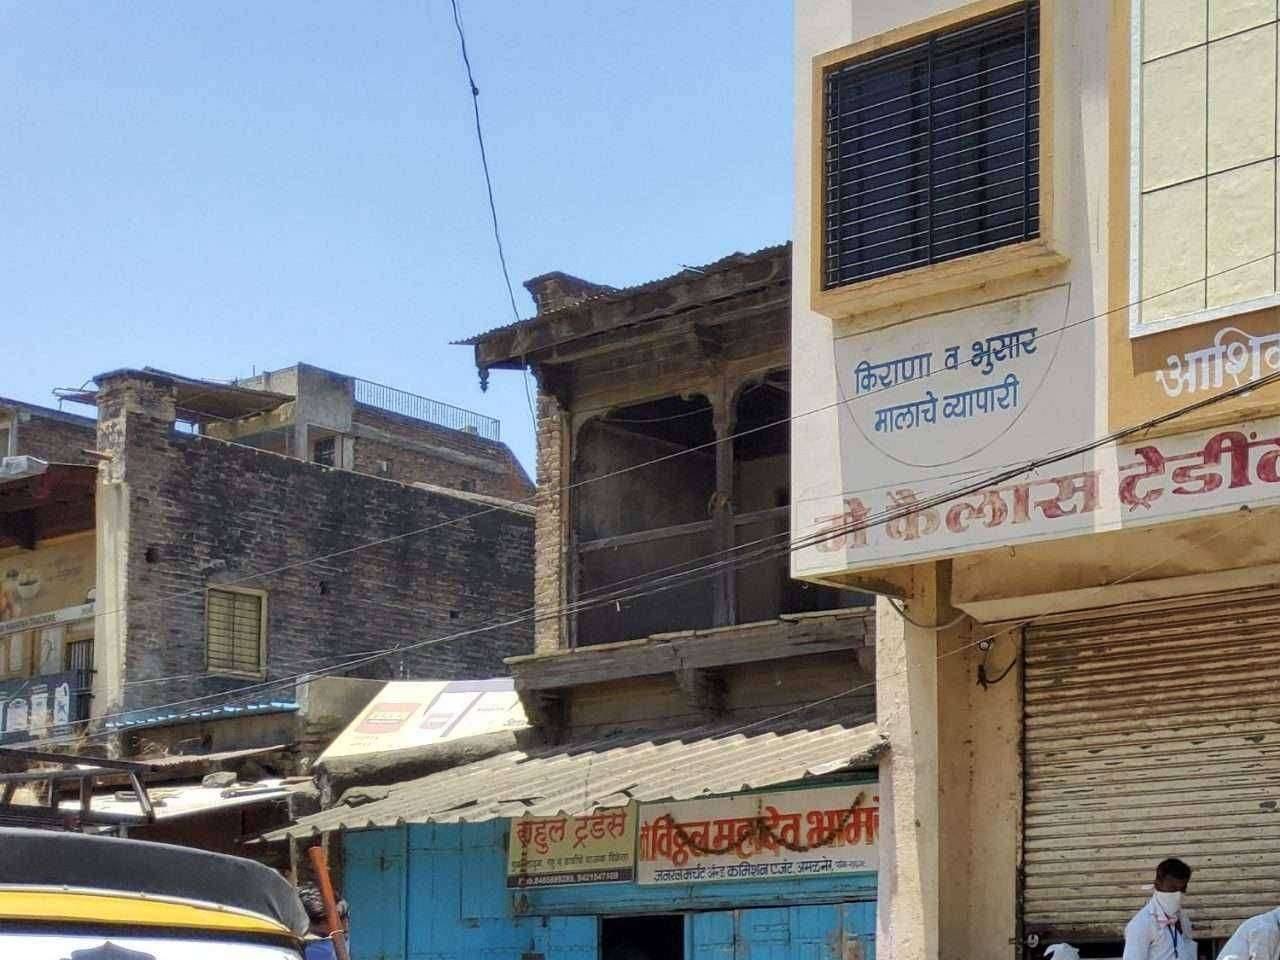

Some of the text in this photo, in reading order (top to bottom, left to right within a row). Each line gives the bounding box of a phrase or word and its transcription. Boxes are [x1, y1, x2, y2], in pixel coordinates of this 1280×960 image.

[854, 326, 1039, 395] किराणा व भुसार
[873, 372, 1020, 435] मालाचे व्यापारी
